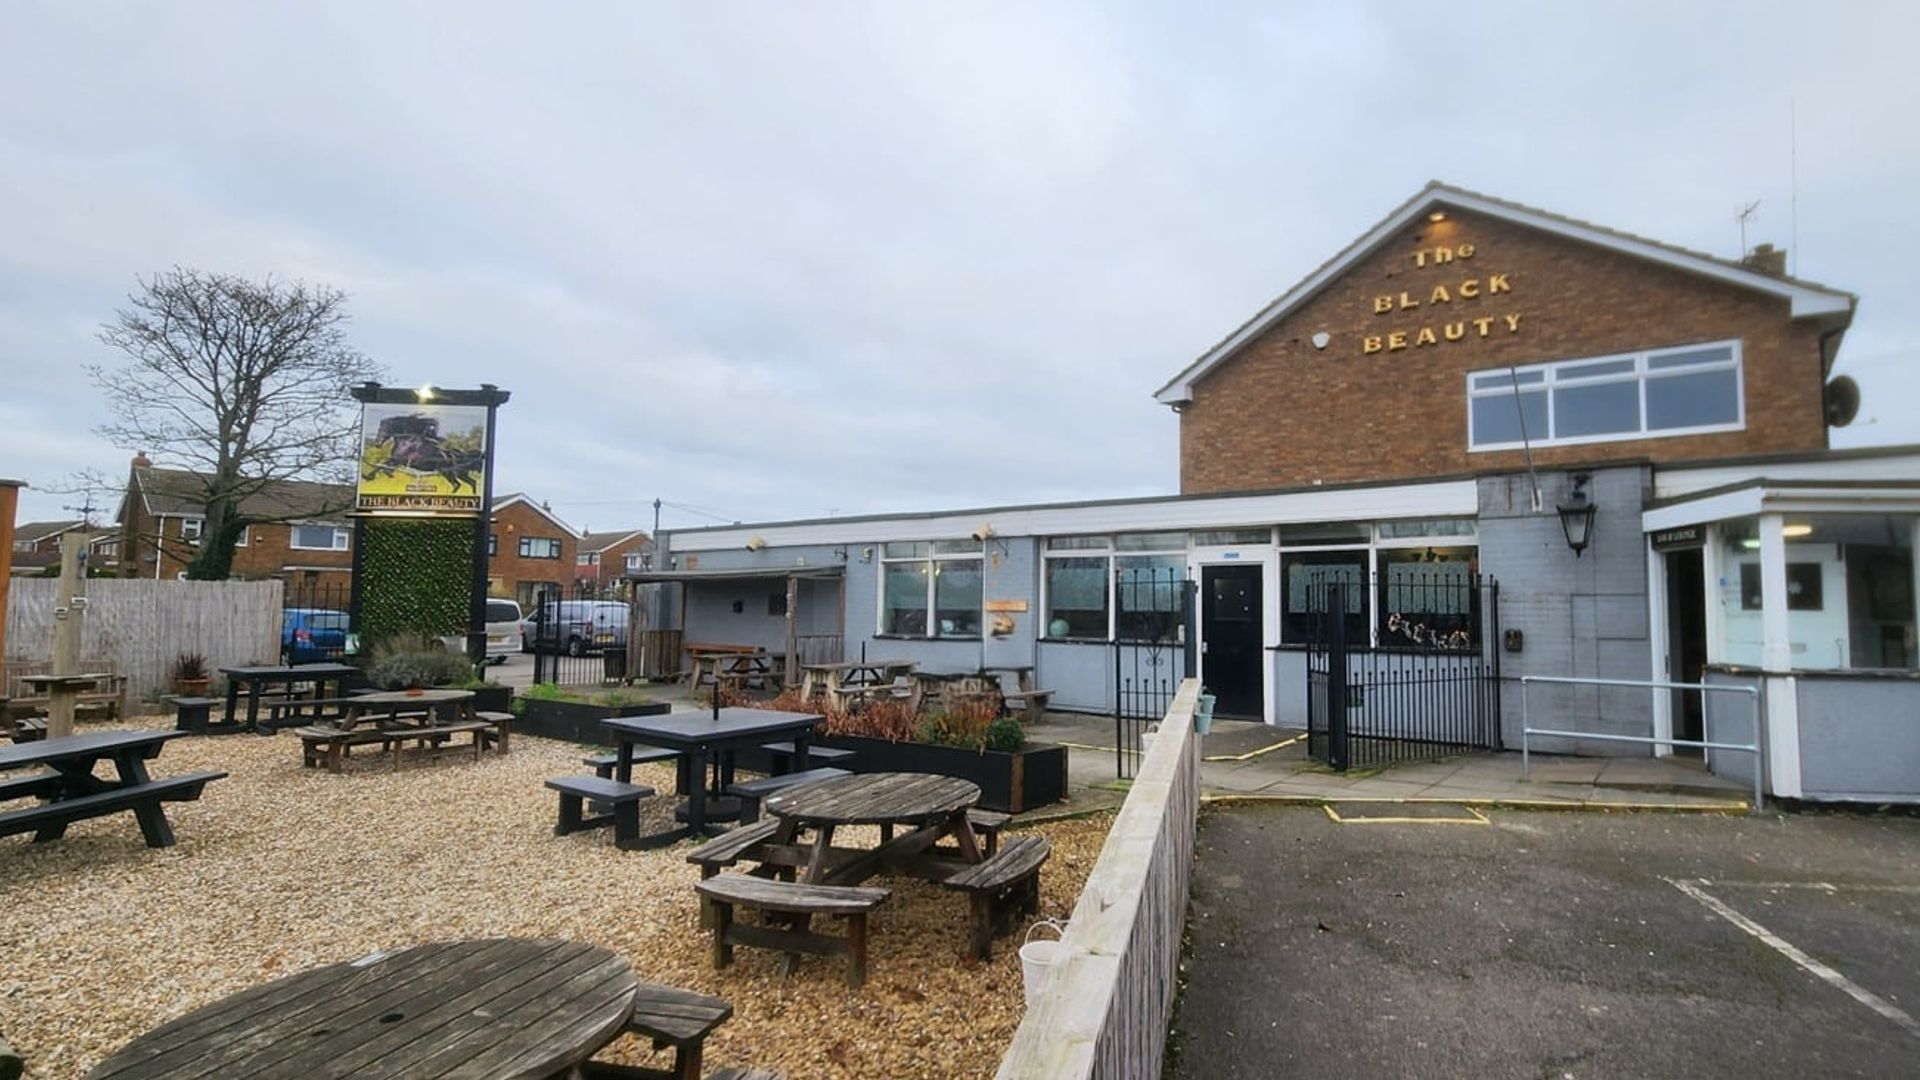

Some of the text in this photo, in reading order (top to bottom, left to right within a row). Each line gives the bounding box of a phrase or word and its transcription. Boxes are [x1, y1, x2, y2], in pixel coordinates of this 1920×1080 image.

[1413, 244, 1475, 268] The
[1373, 273, 1511, 315] BLACK
[1363, 313, 1521, 354] BEAUTY
[362, 497, 479, 508] THE BLACK BEAUTY
